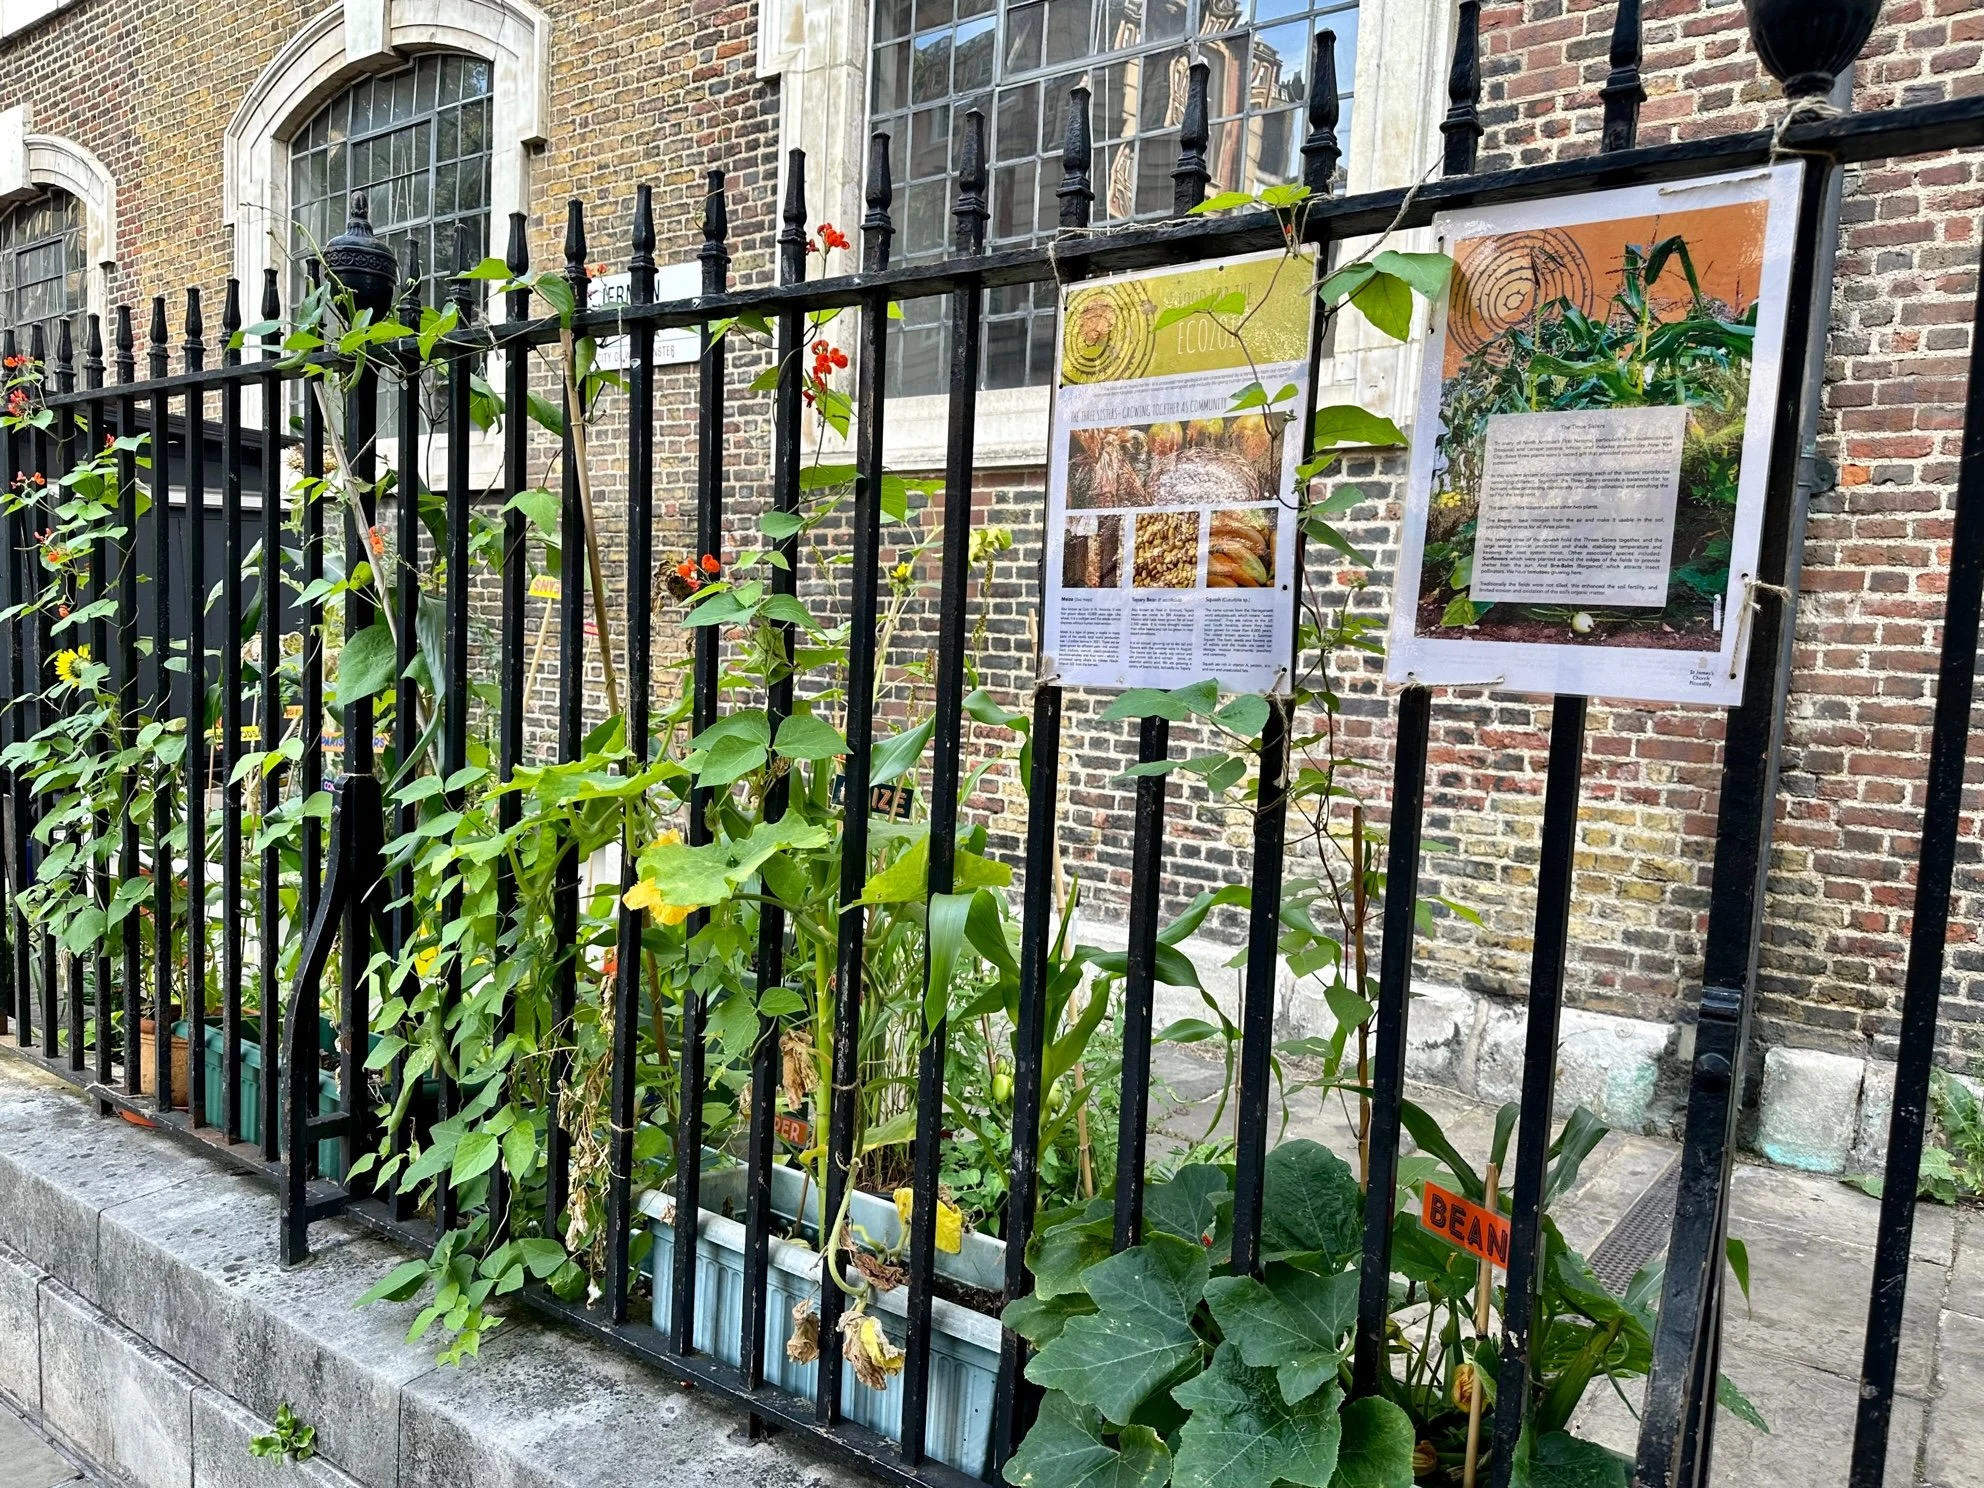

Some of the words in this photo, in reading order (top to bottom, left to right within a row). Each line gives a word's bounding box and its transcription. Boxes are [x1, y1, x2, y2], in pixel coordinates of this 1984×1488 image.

[602, 278, 661, 304] JERN
[1177, 315, 1247, 355] ECOZOI
[597, 351, 613, 364] CITY
[1081, 409, 1096, 422] THREE
[1122, 404, 1151, 419] GROWING
[1152, 401, 1180, 416] TOGETHER
[1181, 400, 1189, 414] AS
[1189, 397, 1227, 413] COMMUNITY
[533, 579, 561, 595] EANS
[1429, 1192, 1509, 1264] BEAN
